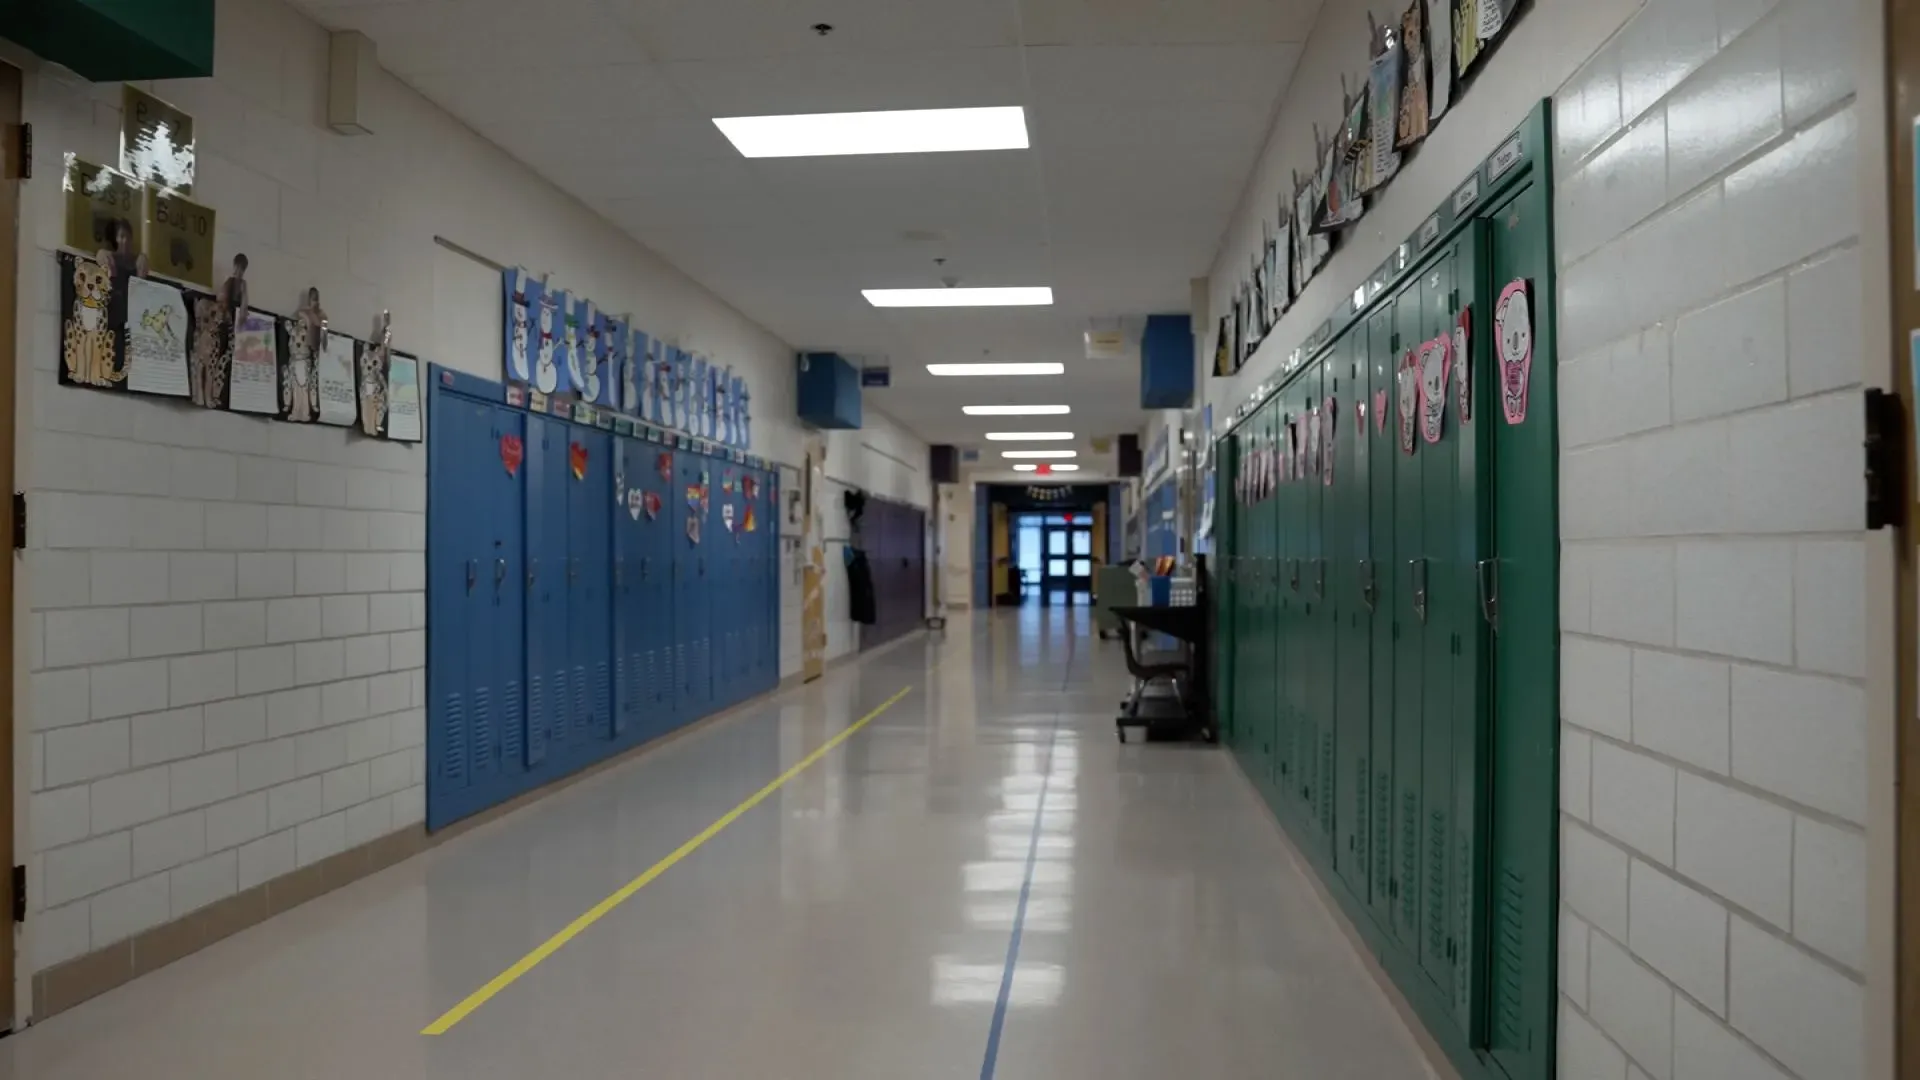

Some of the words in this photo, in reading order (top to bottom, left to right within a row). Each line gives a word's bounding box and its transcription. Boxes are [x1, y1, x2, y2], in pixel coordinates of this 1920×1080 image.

[122, 189, 131, 211] 8
[156, 199, 187, 232] Bus
[193, 213, 208, 237] 10
